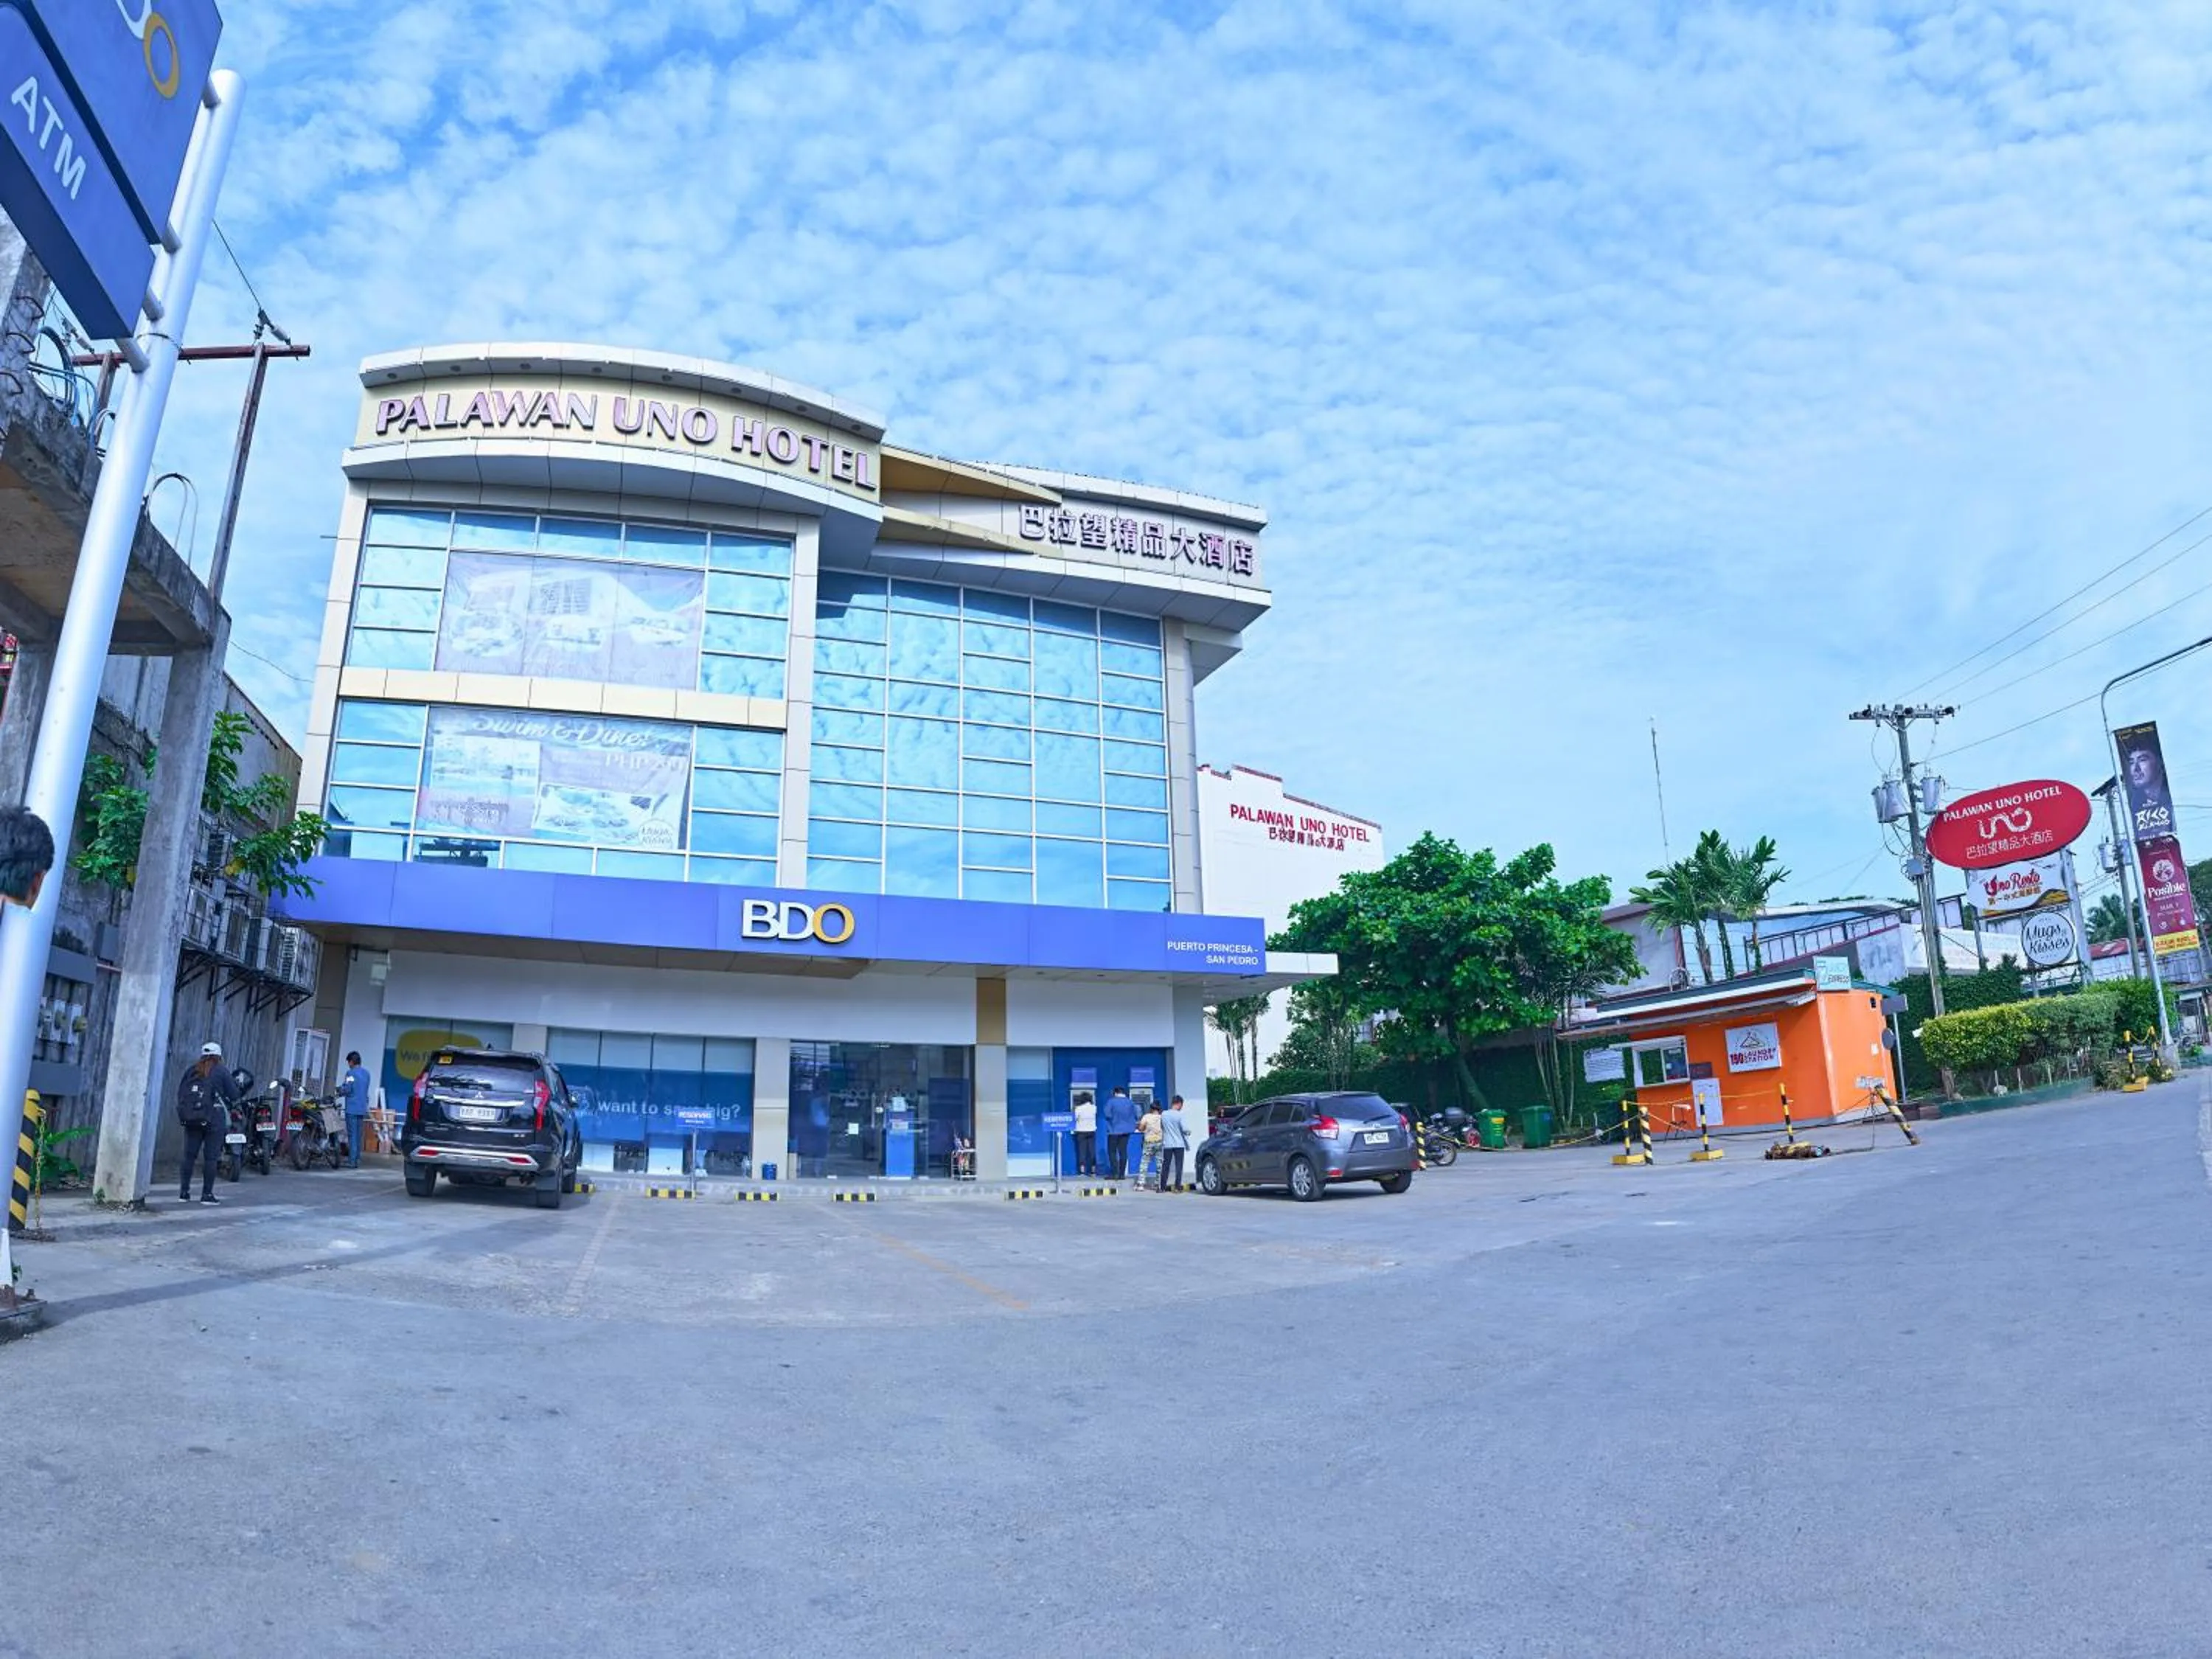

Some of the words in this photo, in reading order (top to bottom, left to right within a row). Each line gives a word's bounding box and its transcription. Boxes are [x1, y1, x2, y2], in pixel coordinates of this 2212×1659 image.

[11, 76, 86, 200] ATM
[376, 391, 597, 434] PALAWAN
[612, 396, 718, 444] UNO
[731, 415, 877, 490] HOTEL
[1019, 504, 1253, 575] 巴拉望精品大酒店
[1229, 803, 1293, 829] PALAWAN
[1300, 816, 1326, 834] UNO
[1332, 822, 1371, 843] HOTEL
[1943, 801, 1992, 823] PALAWAN
[1995, 795, 2022, 810] UNO
[2025, 785, 2062, 802] HOTEL
[741, 899, 855, 944] BDO
[1167, 941, 1205, 952] PUERTO
[1207, 943, 1253, 953] PRINCESA
[1206, 955, 1225, 964] SAN
[1227, 956, 1259, 965] PEDRO
[2028, 937, 2070, 955] Kisses
[597, 1100, 637, 1114] want
[640, 1101, 658, 1115] to
